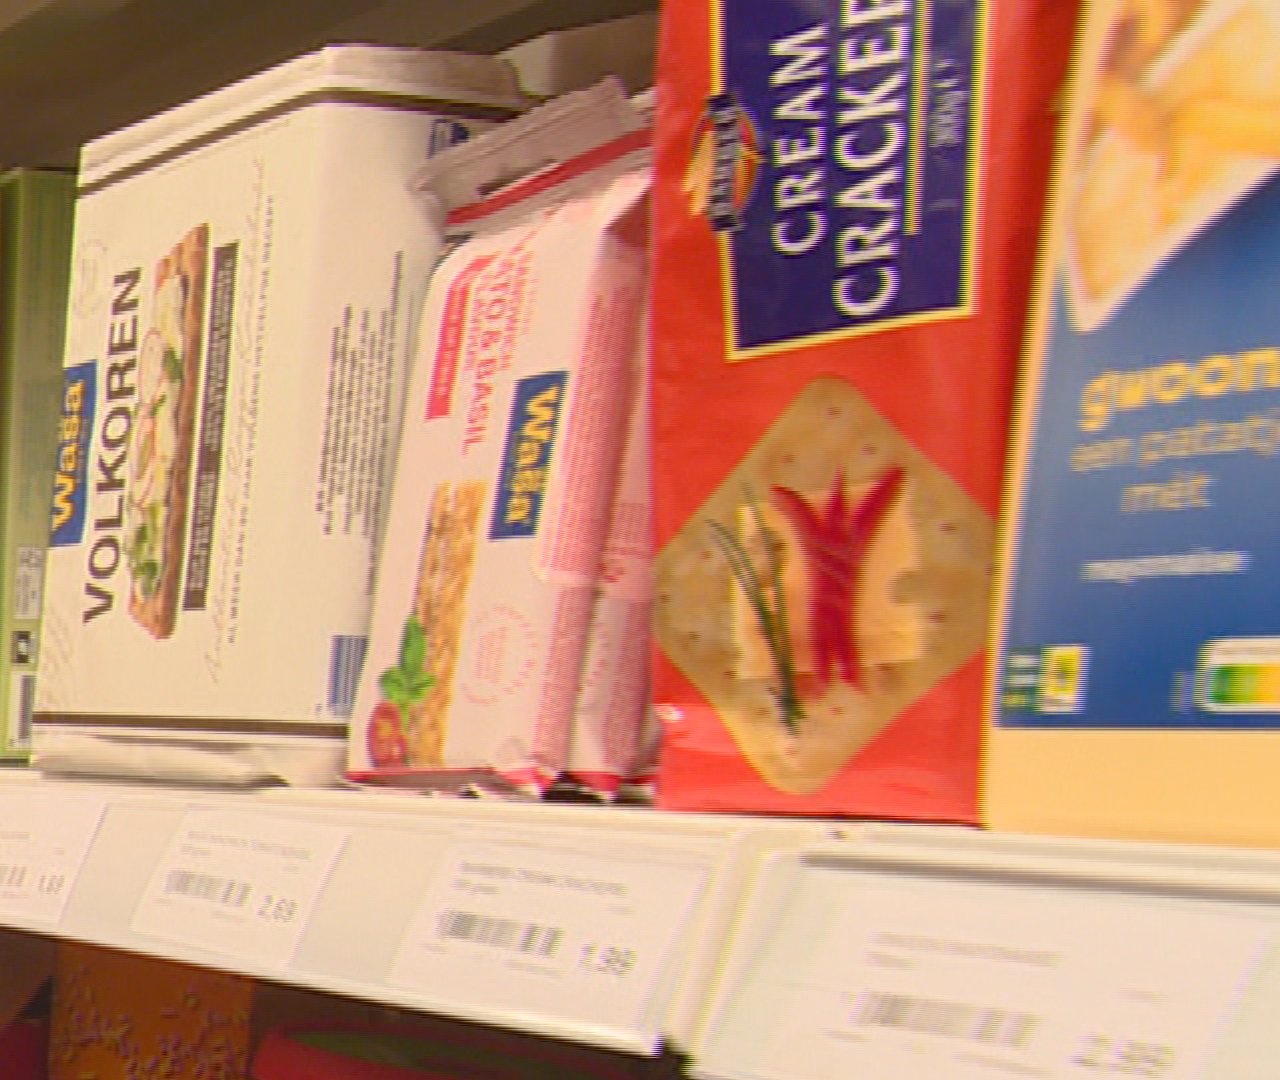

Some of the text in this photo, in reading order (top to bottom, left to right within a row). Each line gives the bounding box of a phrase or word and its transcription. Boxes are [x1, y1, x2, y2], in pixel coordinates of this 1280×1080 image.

[768, 22, 830, 257] CREAM
[51, 380, 86, 530] Wasa
[82, 266, 142, 623] VOLKOREN
[506, 384, 562, 526] Wasa
